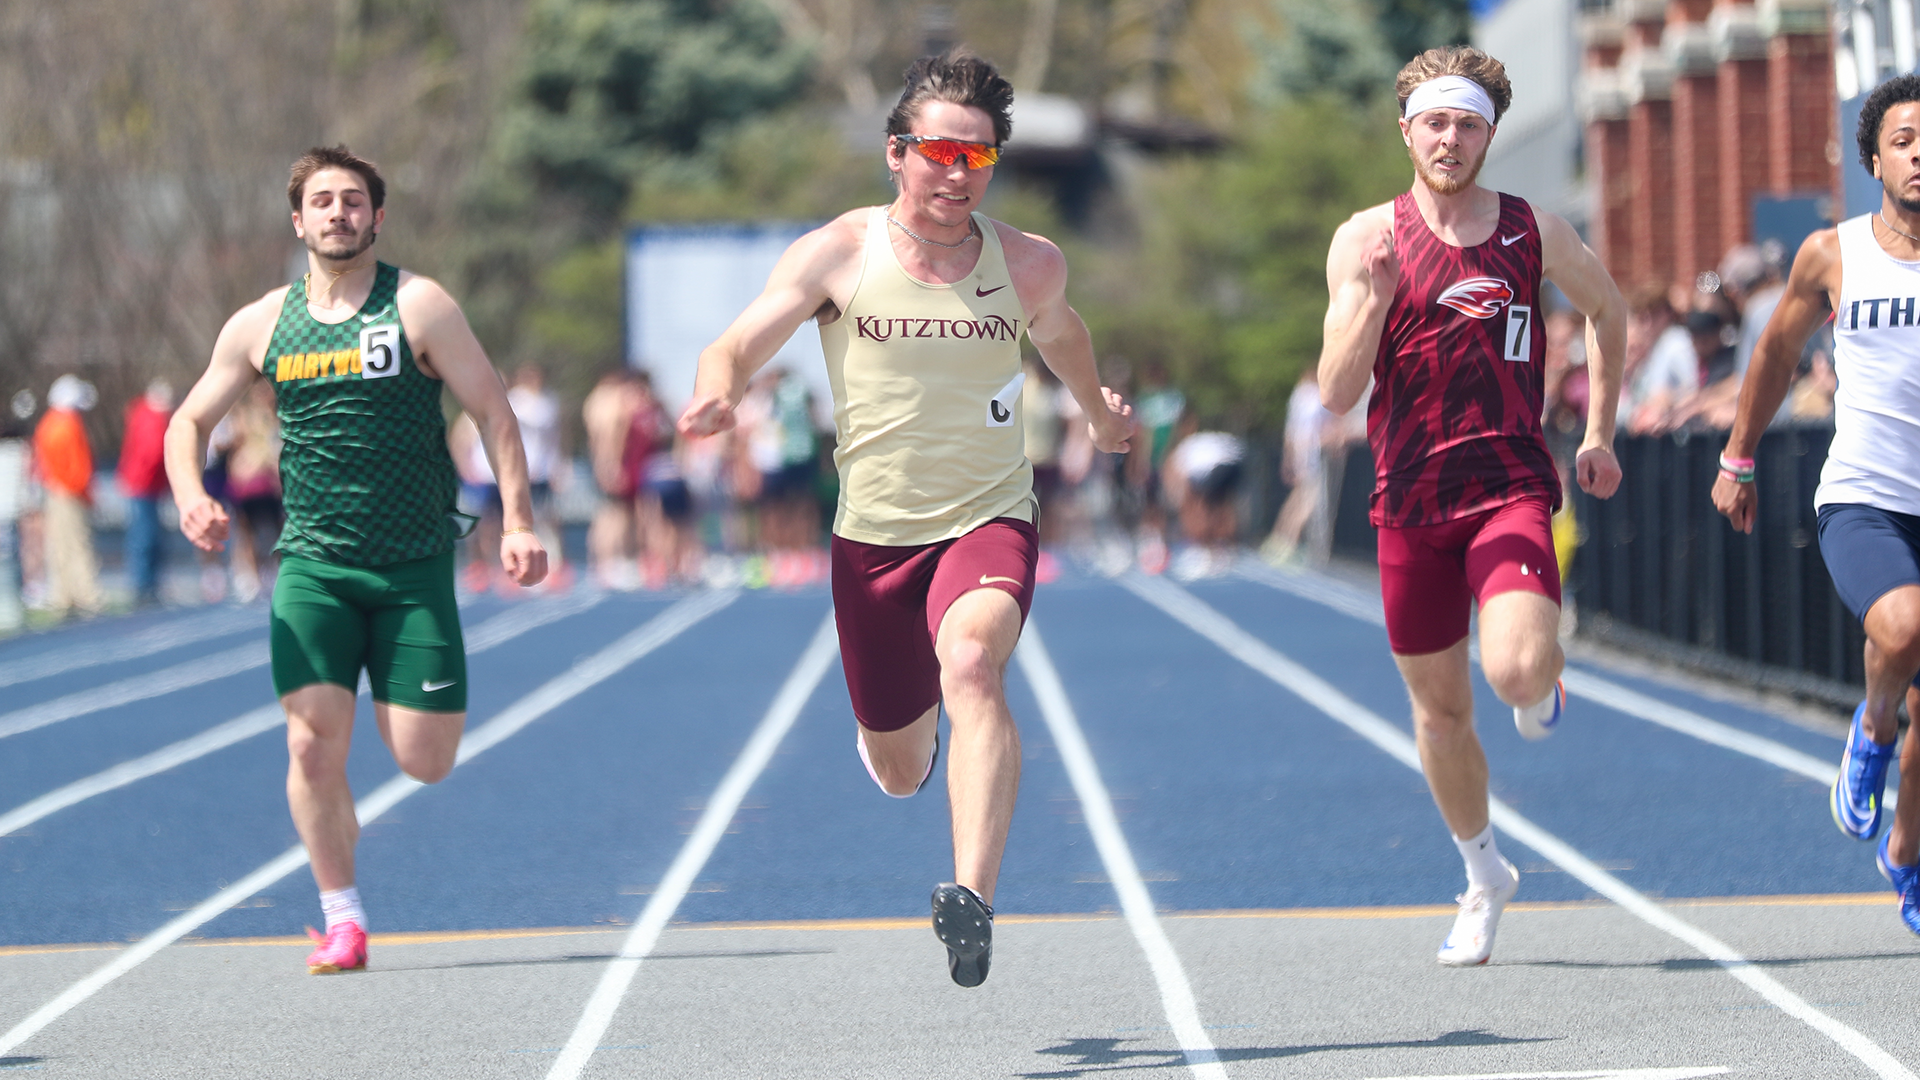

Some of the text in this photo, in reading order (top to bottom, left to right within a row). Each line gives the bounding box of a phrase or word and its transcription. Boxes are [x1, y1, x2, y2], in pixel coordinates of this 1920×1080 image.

[855, 314, 1019, 342] KUTZTOWN
[1850, 297, 1920, 331] ITH
[367, 330, 392, 371] 5
[1511, 310, 1529, 357] 7
[276, 347, 363, 382] MARYWO
